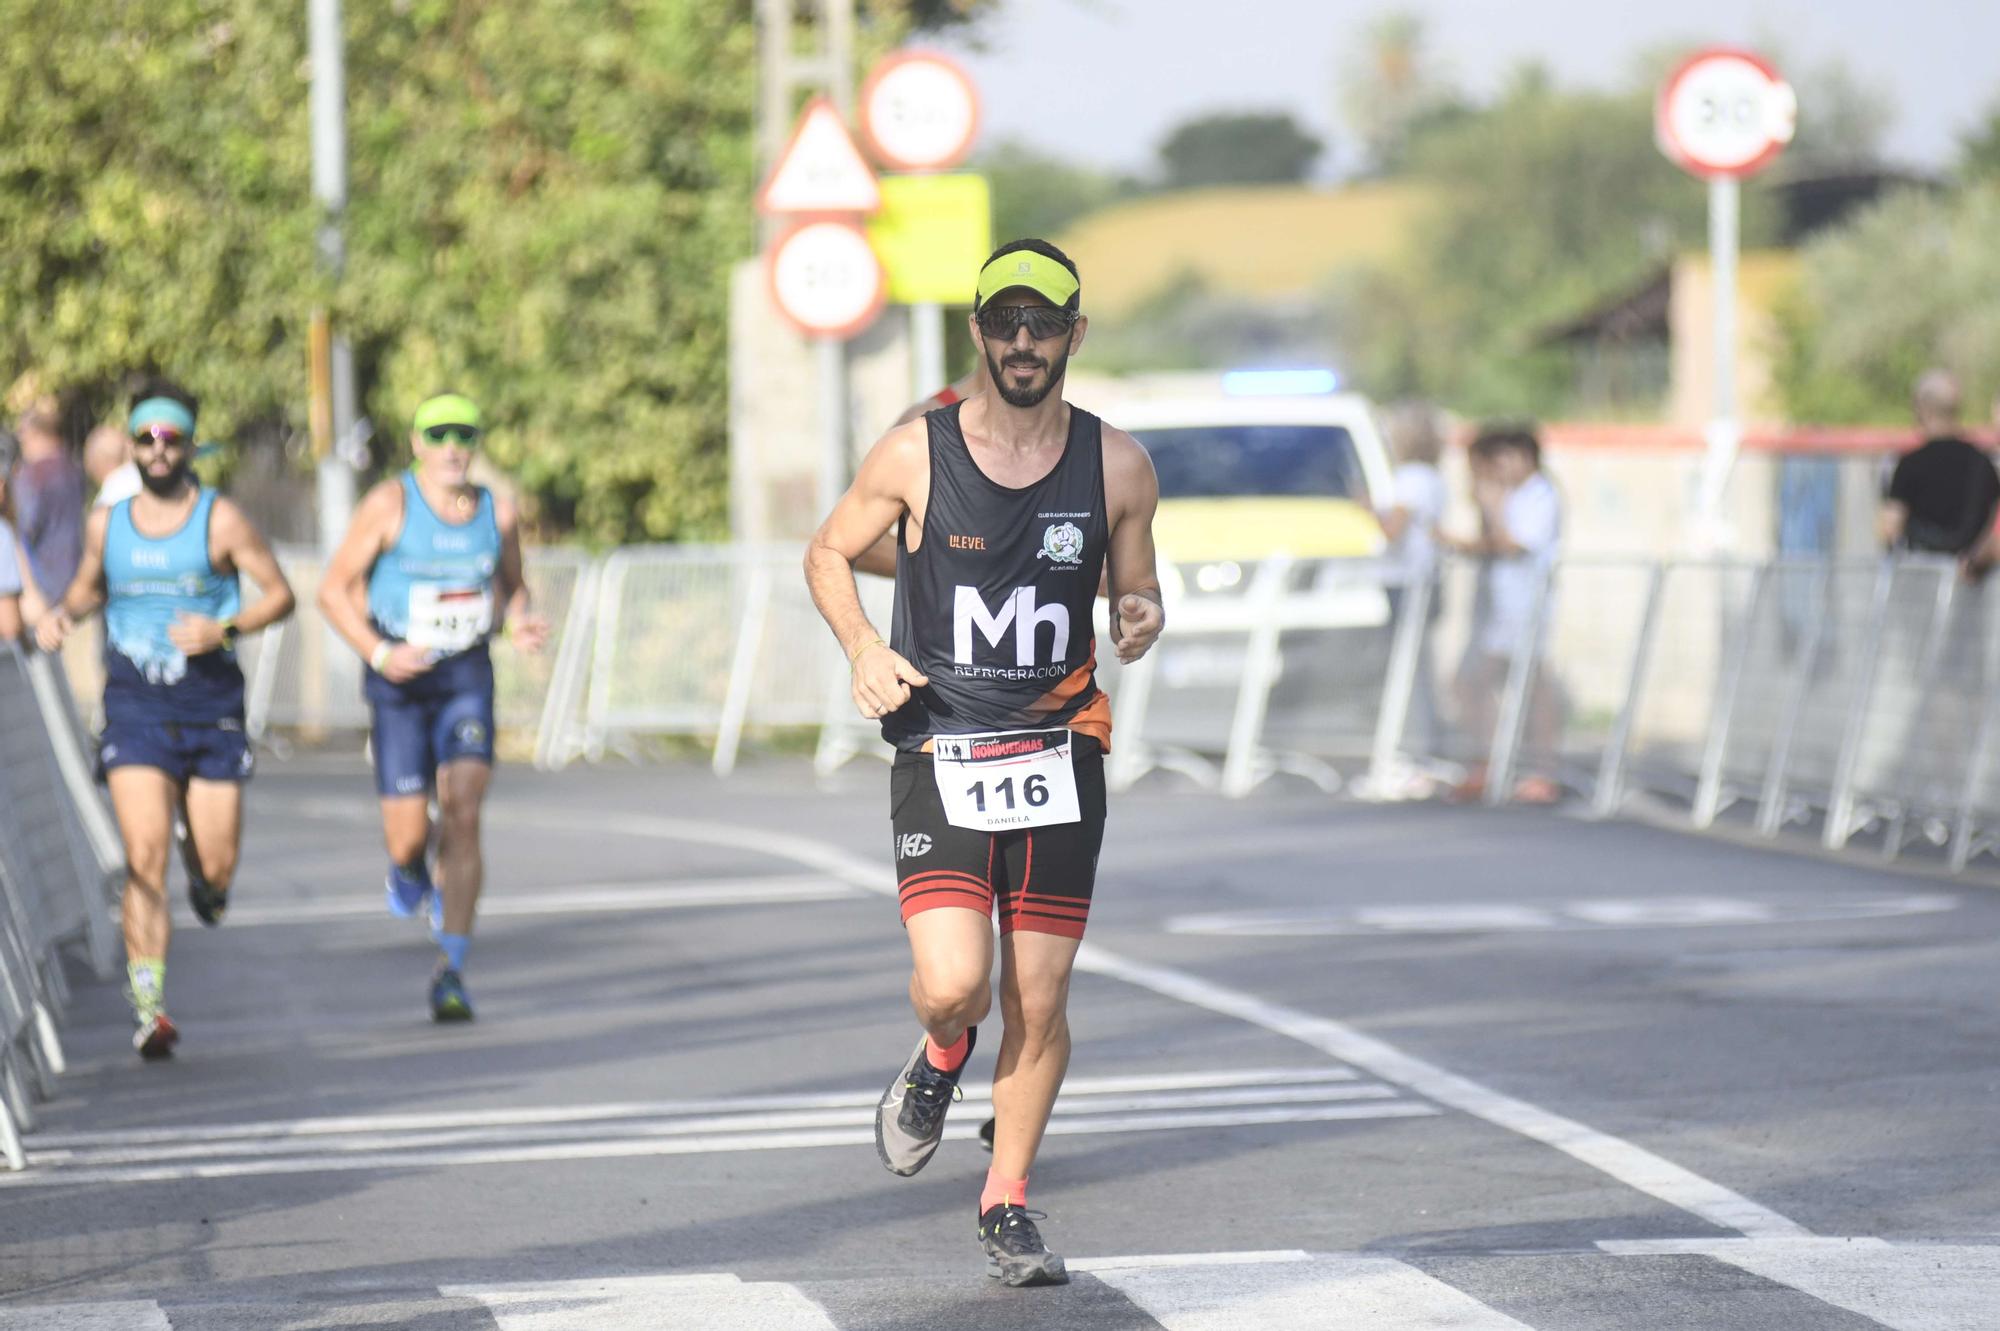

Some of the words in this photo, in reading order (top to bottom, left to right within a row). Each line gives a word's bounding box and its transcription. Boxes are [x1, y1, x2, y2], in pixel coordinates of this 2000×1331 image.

[953, 585, 1070, 667] Mh
[954, 664, 1067, 681] REFRIGERACIÓN
[972, 739, 1043, 760] NONDUERMAS
[966, 774, 1049, 812] 116
[987, 815, 1031, 825] DANIELA
